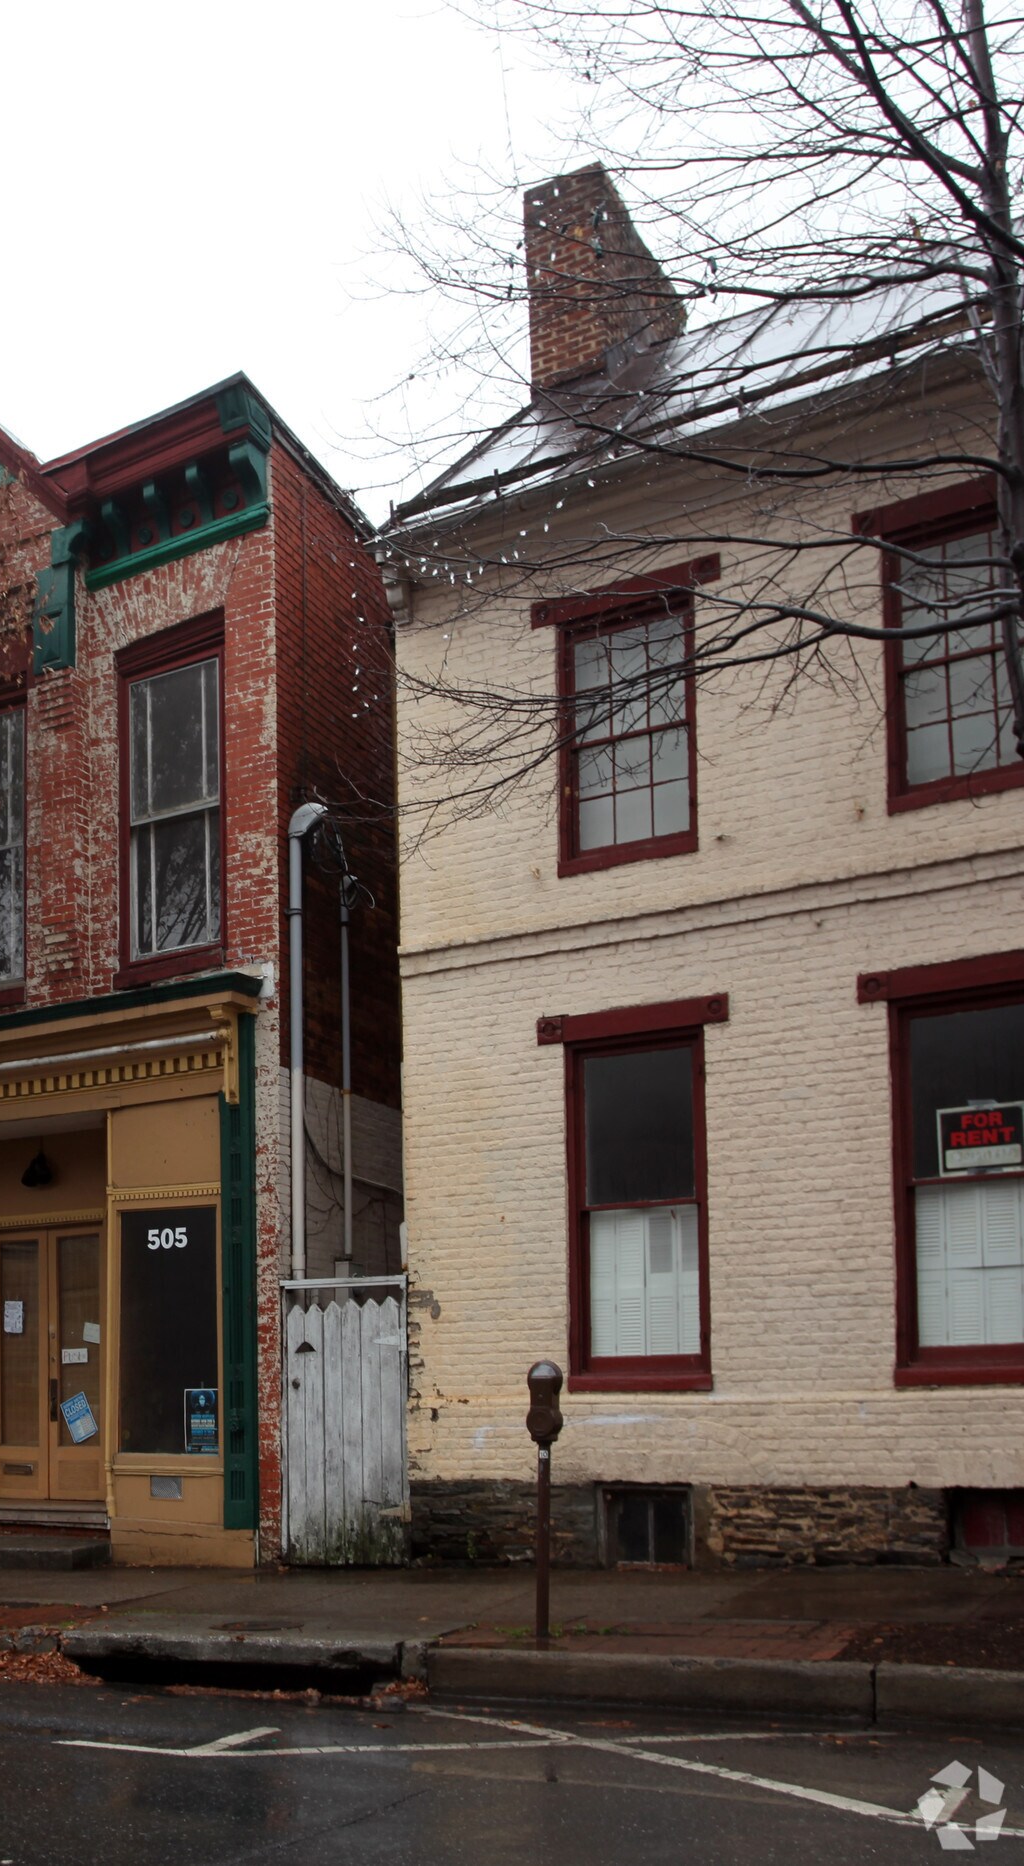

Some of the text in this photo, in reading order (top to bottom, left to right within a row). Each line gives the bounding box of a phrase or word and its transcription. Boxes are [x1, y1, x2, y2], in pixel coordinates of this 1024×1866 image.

[960, 1111, 1003, 1130] FOR
[950, 1126, 1016, 1147] RENT
[147, 1227, 188, 1250] 505
[64, 1399, 87, 1418] CLOSED
